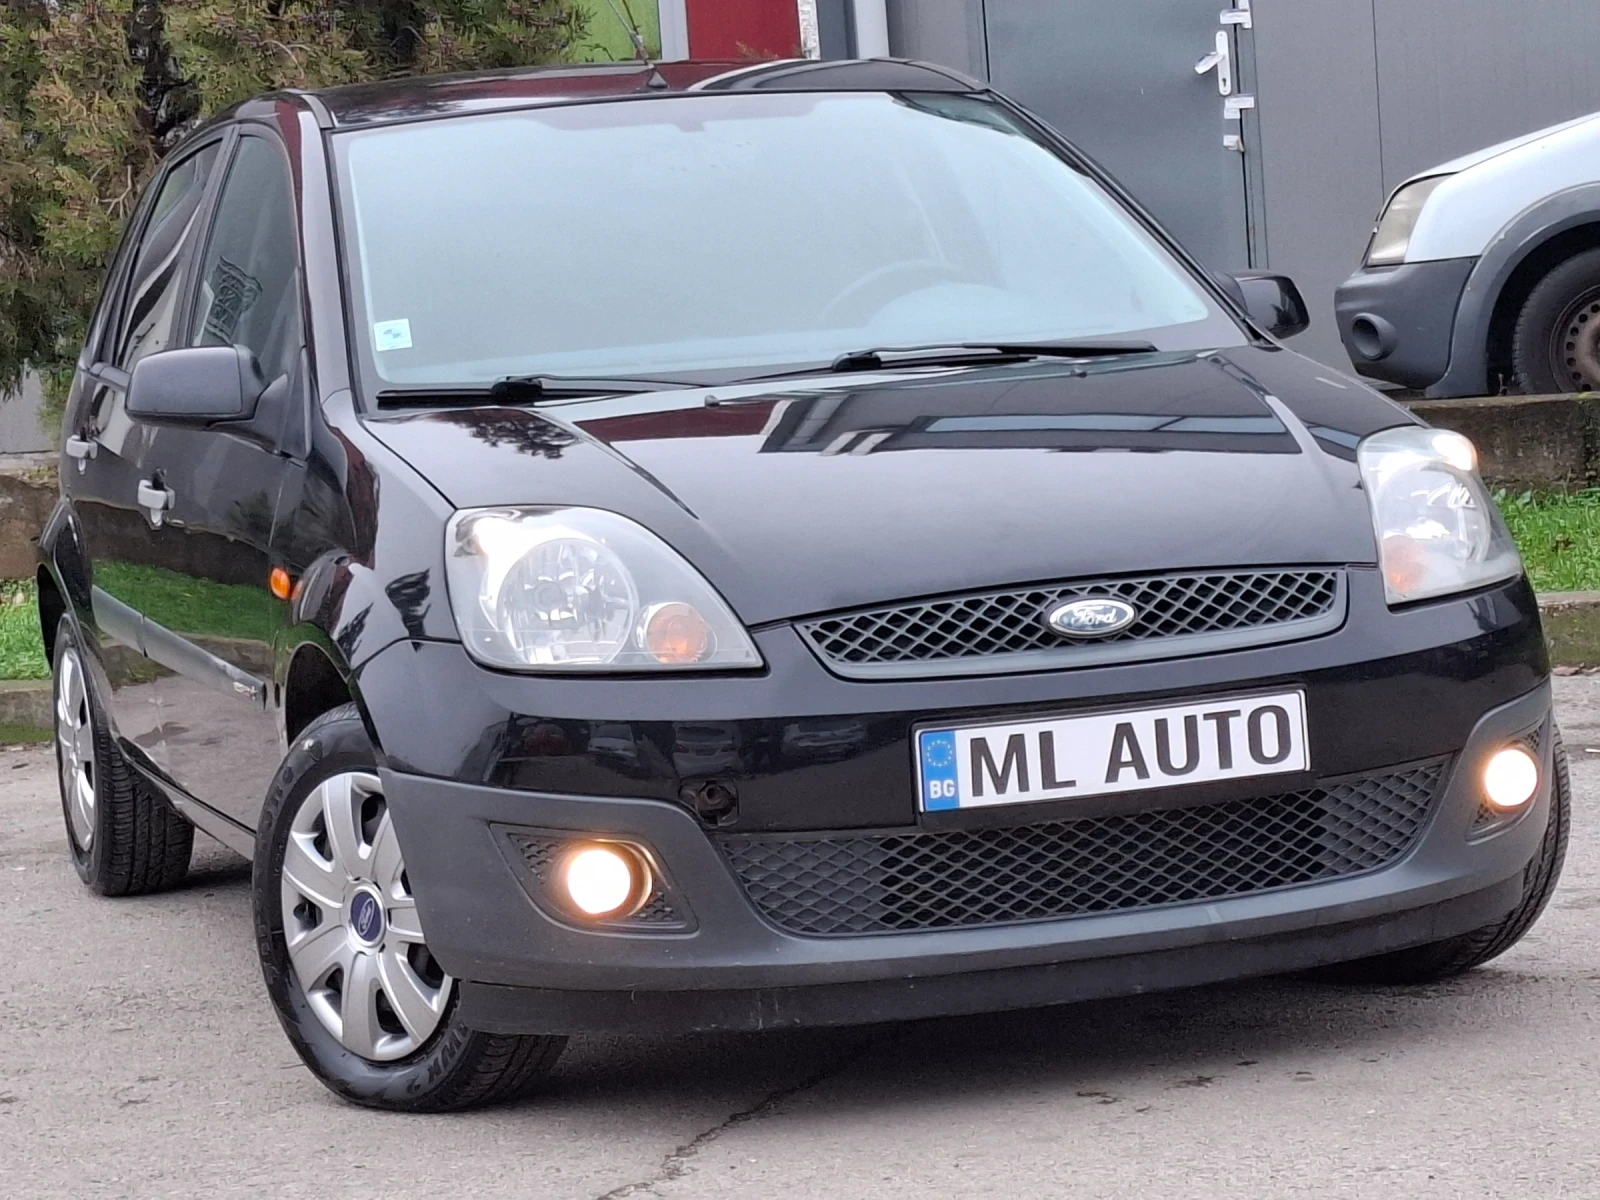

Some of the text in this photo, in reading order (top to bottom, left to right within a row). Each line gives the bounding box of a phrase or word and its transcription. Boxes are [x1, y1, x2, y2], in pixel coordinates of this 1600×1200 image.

[1071, 605, 1117, 626] Ford
[970, 704, 1292, 797] ML AUTO
[929, 780, 955, 799] BG
